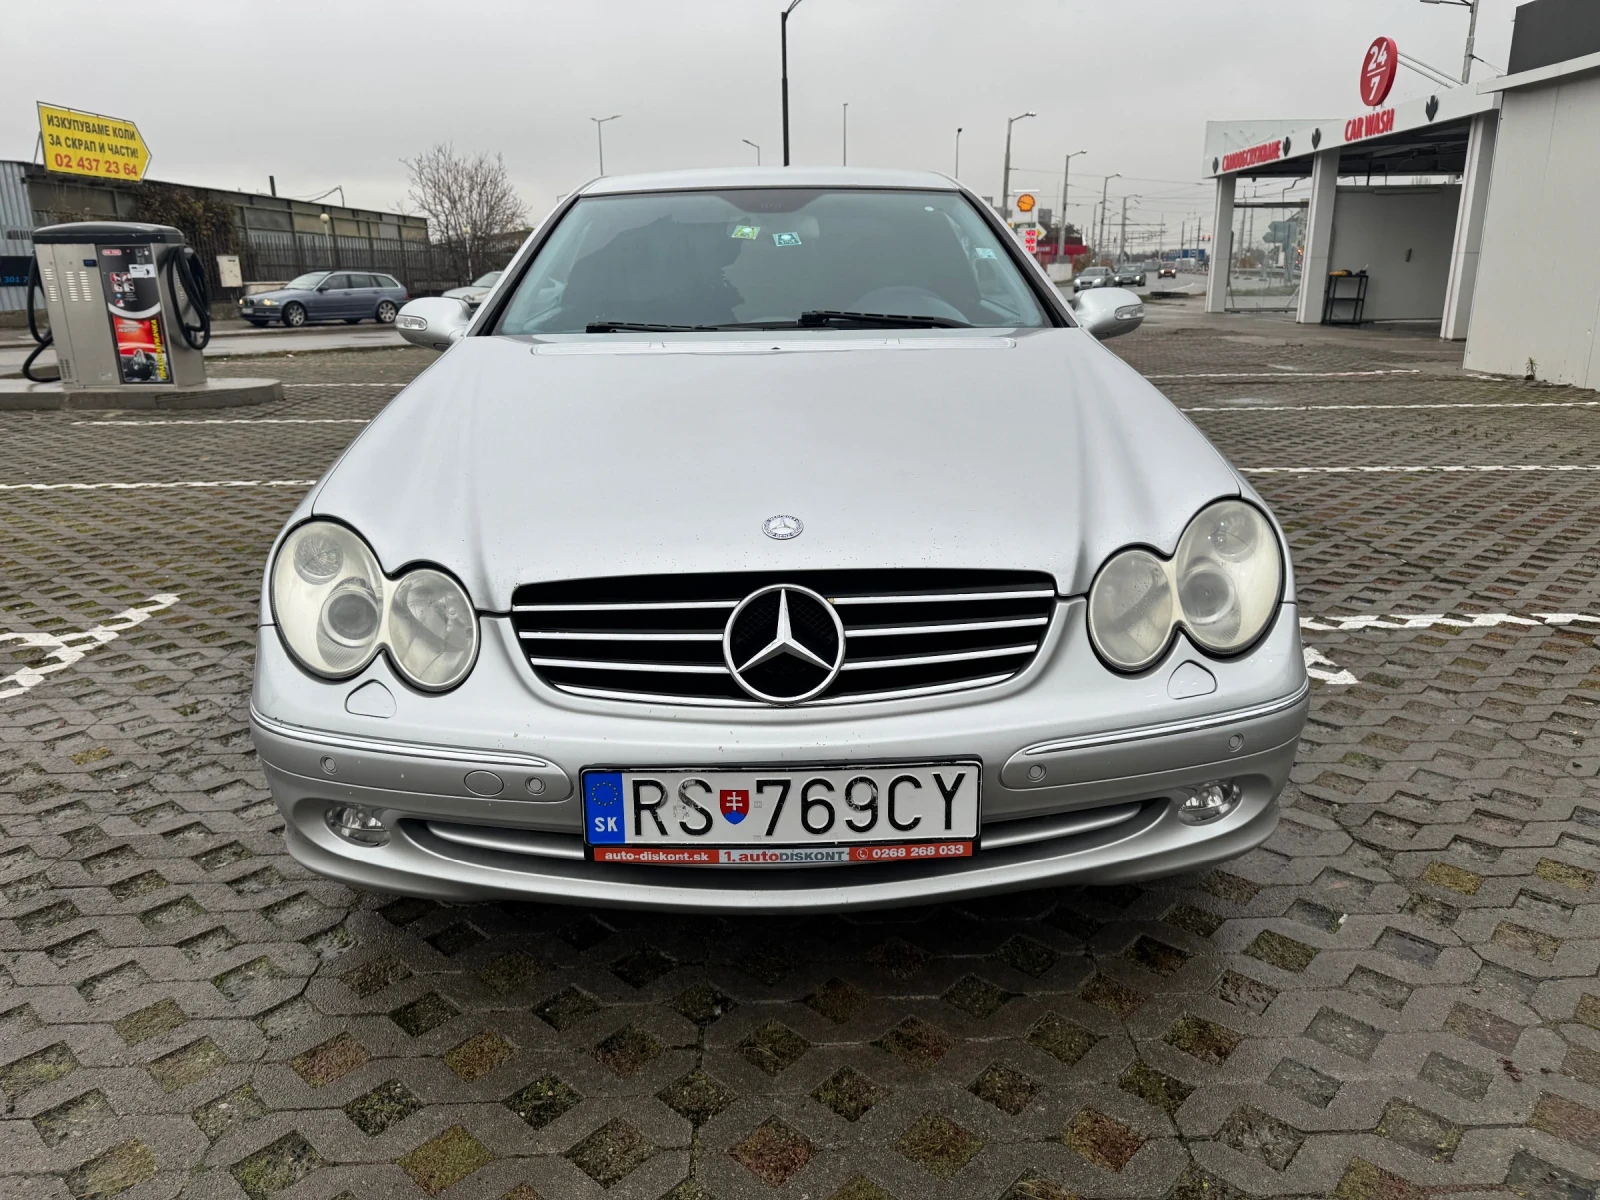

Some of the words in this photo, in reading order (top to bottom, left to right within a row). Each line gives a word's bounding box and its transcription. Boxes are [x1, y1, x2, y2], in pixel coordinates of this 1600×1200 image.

[1367, 41, 1388, 71] 24
[1369, 75, 1381, 101] 7
[46, 114, 111, 137] ИЗКУПУВАМЕ
[112, 126, 136, 141] КОЛИ
[1344, 117, 1364, 142] CAR
[1364, 108, 1395, 138] WASH
[48, 133, 62, 147] ЗА
[64, 136, 97, 152] СКРАП
[98, 142, 106, 154] И
[107, 143, 139, 159] ЧАСТИ!
[54, 153, 73, 169] 02
[77, 156, 100, 172] 437
[104, 160, 120, 175] 23
[123, 162, 138, 177] 64
[632, 777, 714, 837] RS
[755, 771, 967, 838] 769CY
[594, 816, 618, 832] SK
[604, 850, 709, 862] auto-diskont.sk
[725, 851, 736, 862] 1.
[872, 847, 906, 859] 0268
[910, 846, 936, 857] 268
[939, 844, 964, 855] 033
